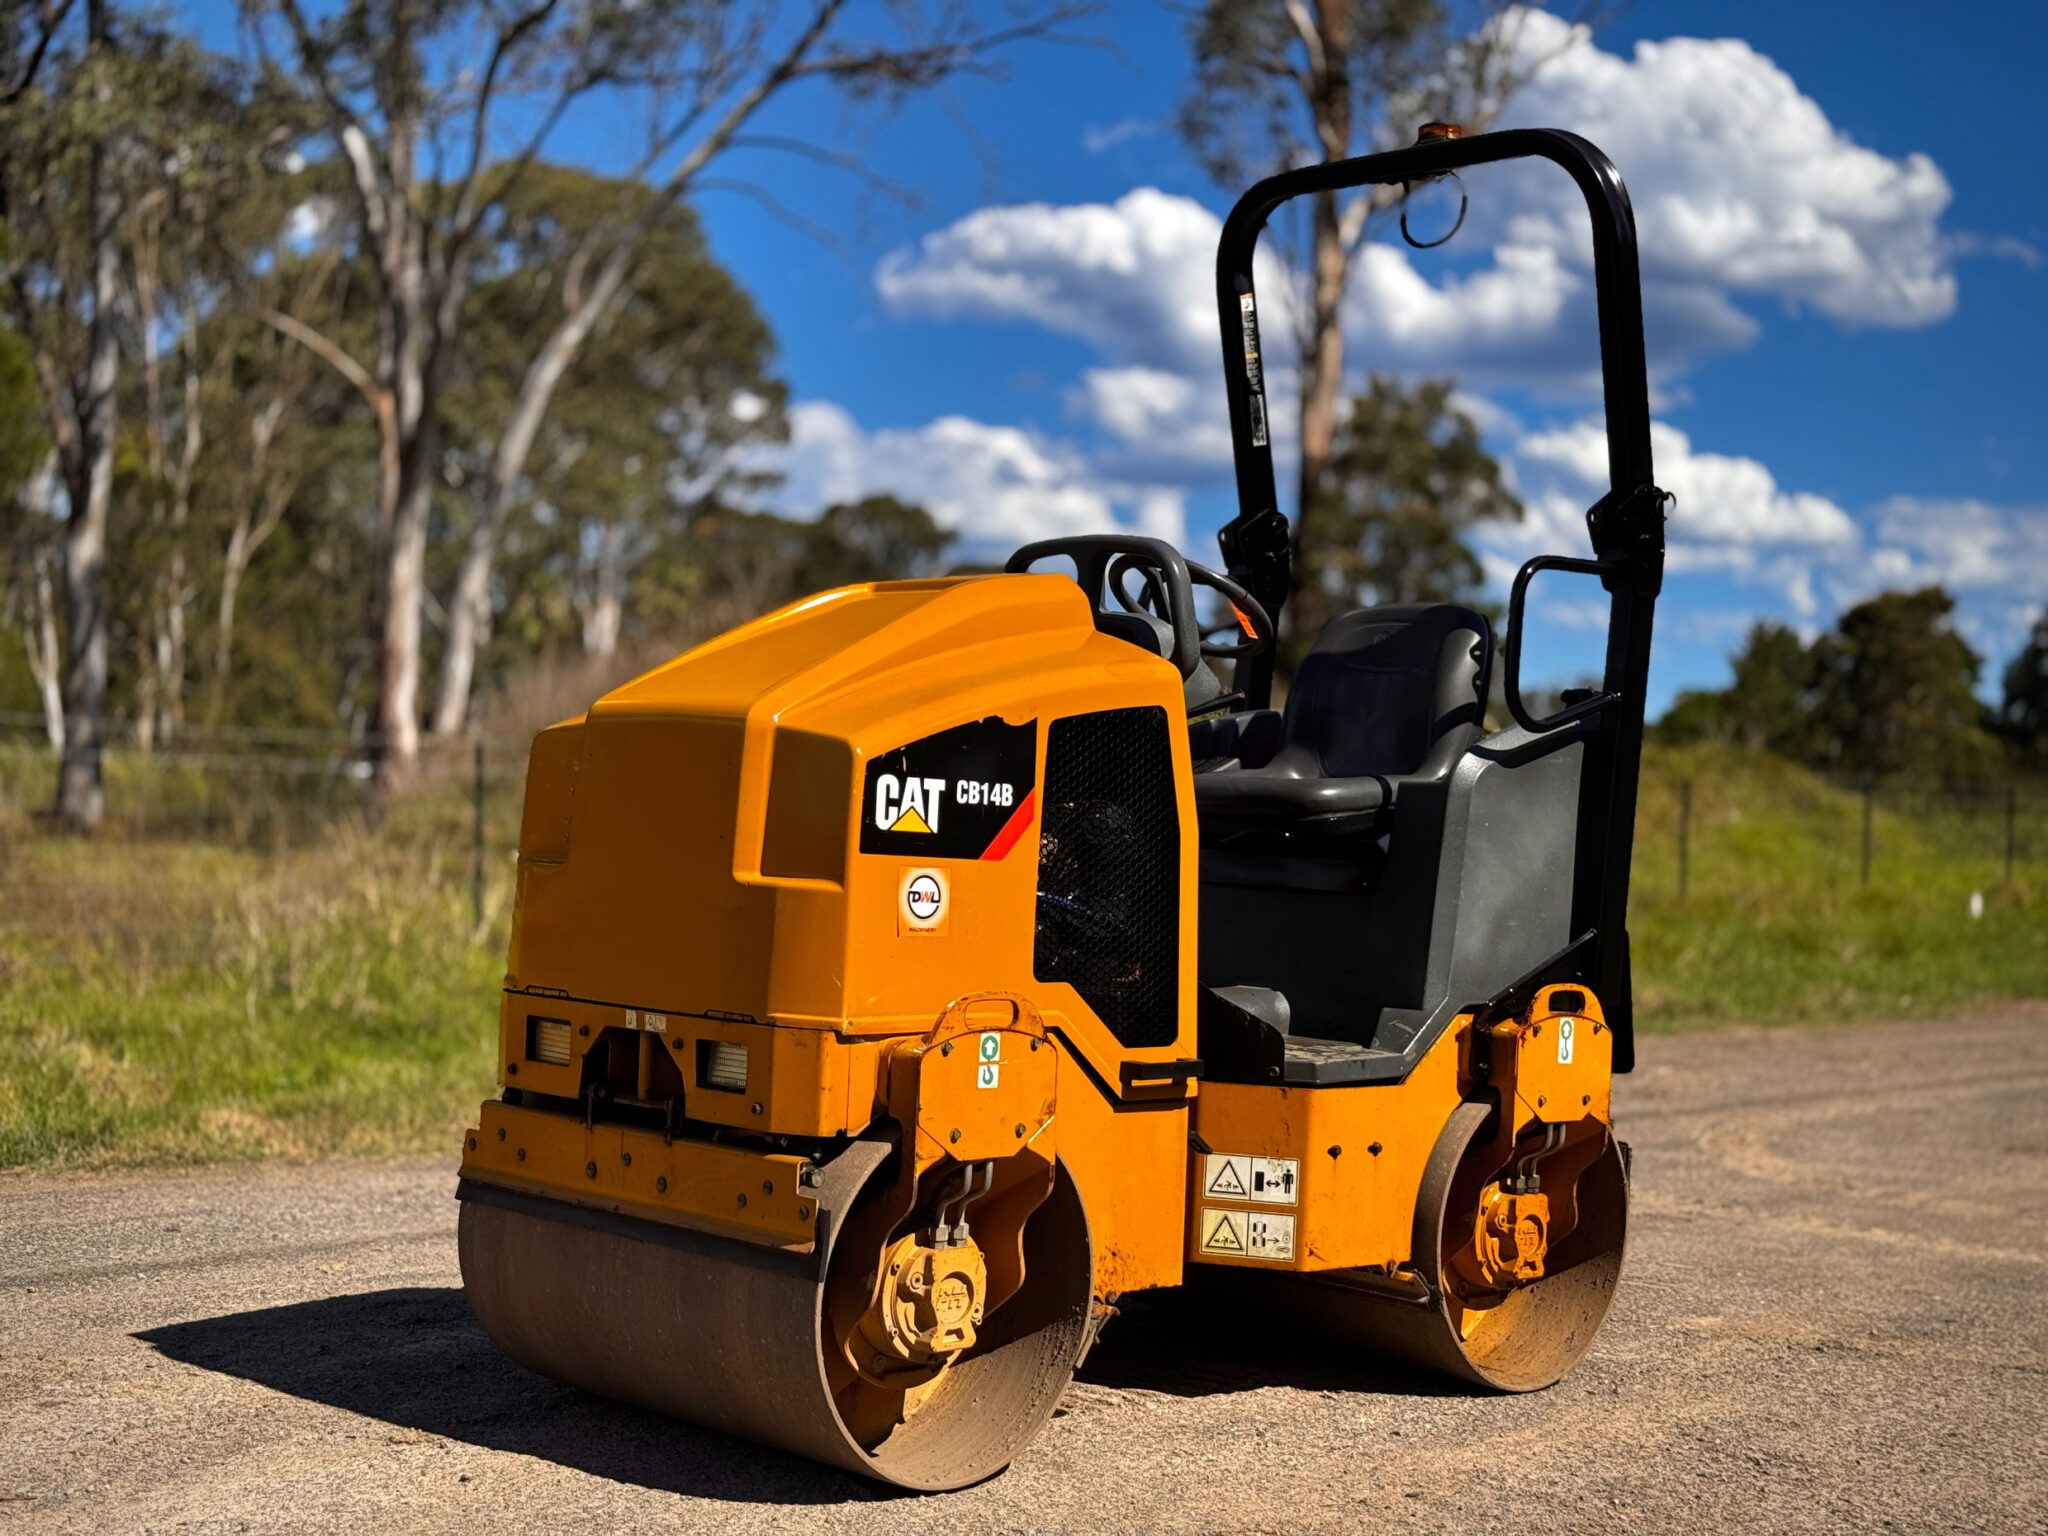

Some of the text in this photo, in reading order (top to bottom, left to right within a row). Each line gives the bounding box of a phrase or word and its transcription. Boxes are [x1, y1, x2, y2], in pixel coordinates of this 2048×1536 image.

[875, 774, 1013, 834] CAT CB14B
[908, 890, 940, 903] DWL
